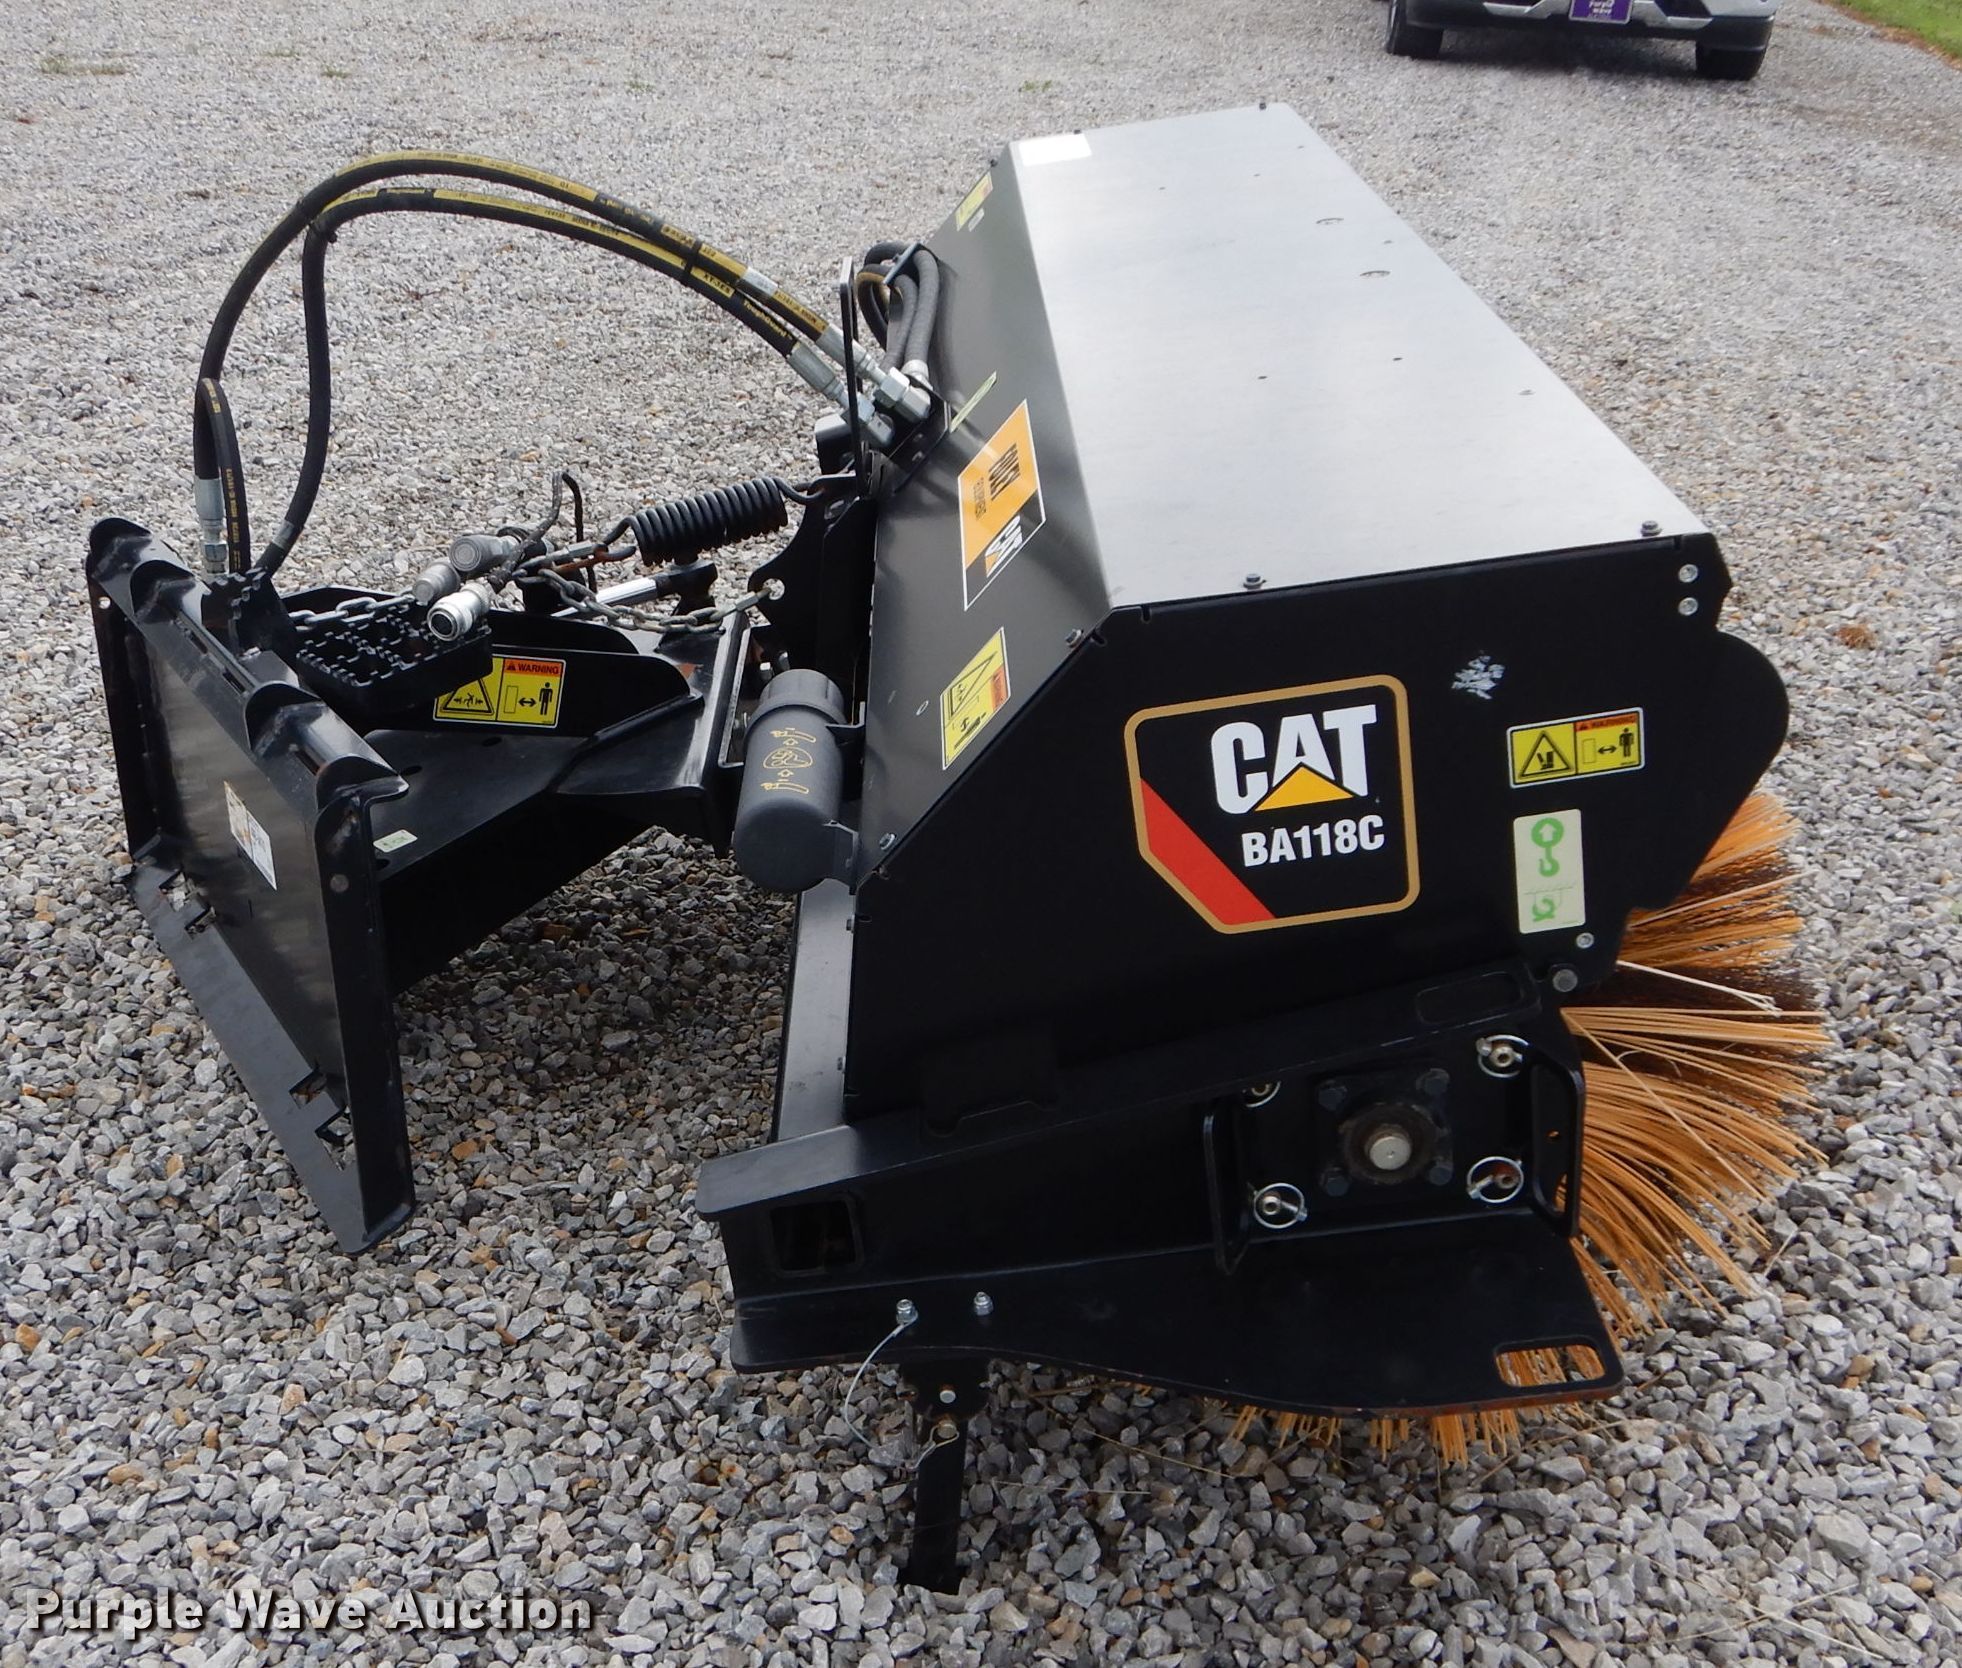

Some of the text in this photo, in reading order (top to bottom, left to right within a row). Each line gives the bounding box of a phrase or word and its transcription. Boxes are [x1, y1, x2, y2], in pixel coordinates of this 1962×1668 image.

[518, 663, 560, 675] WARNING
[1210, 704, 1377, 815] CAT
[1241, 814, 1385, 867] BA118C
